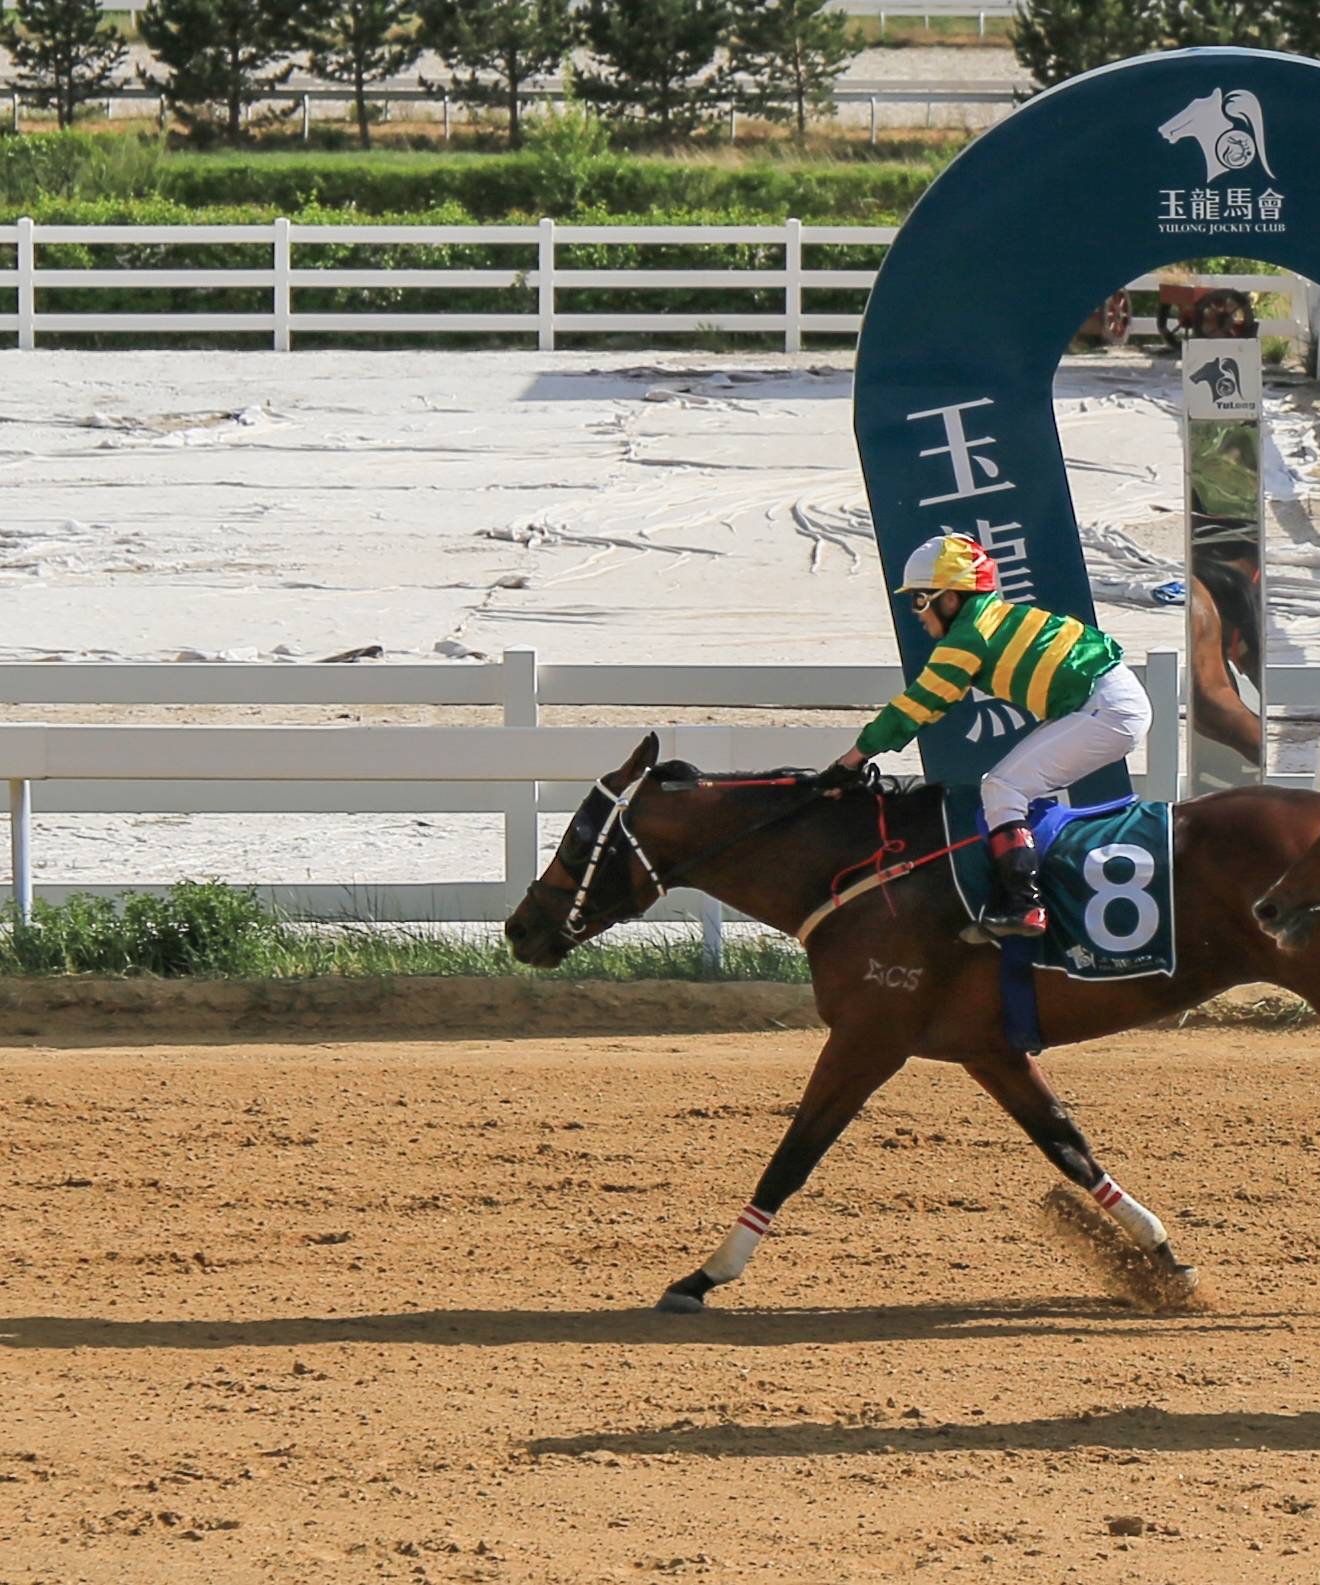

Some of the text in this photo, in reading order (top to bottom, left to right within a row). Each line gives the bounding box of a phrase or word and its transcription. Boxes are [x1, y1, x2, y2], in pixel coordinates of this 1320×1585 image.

[1157, 187, 1285, 220] 玉龍馬會
[1158, 223, 1286, 235] YULONG JOCKEY CLUB
[1083, 843, 1160, 952] 8
